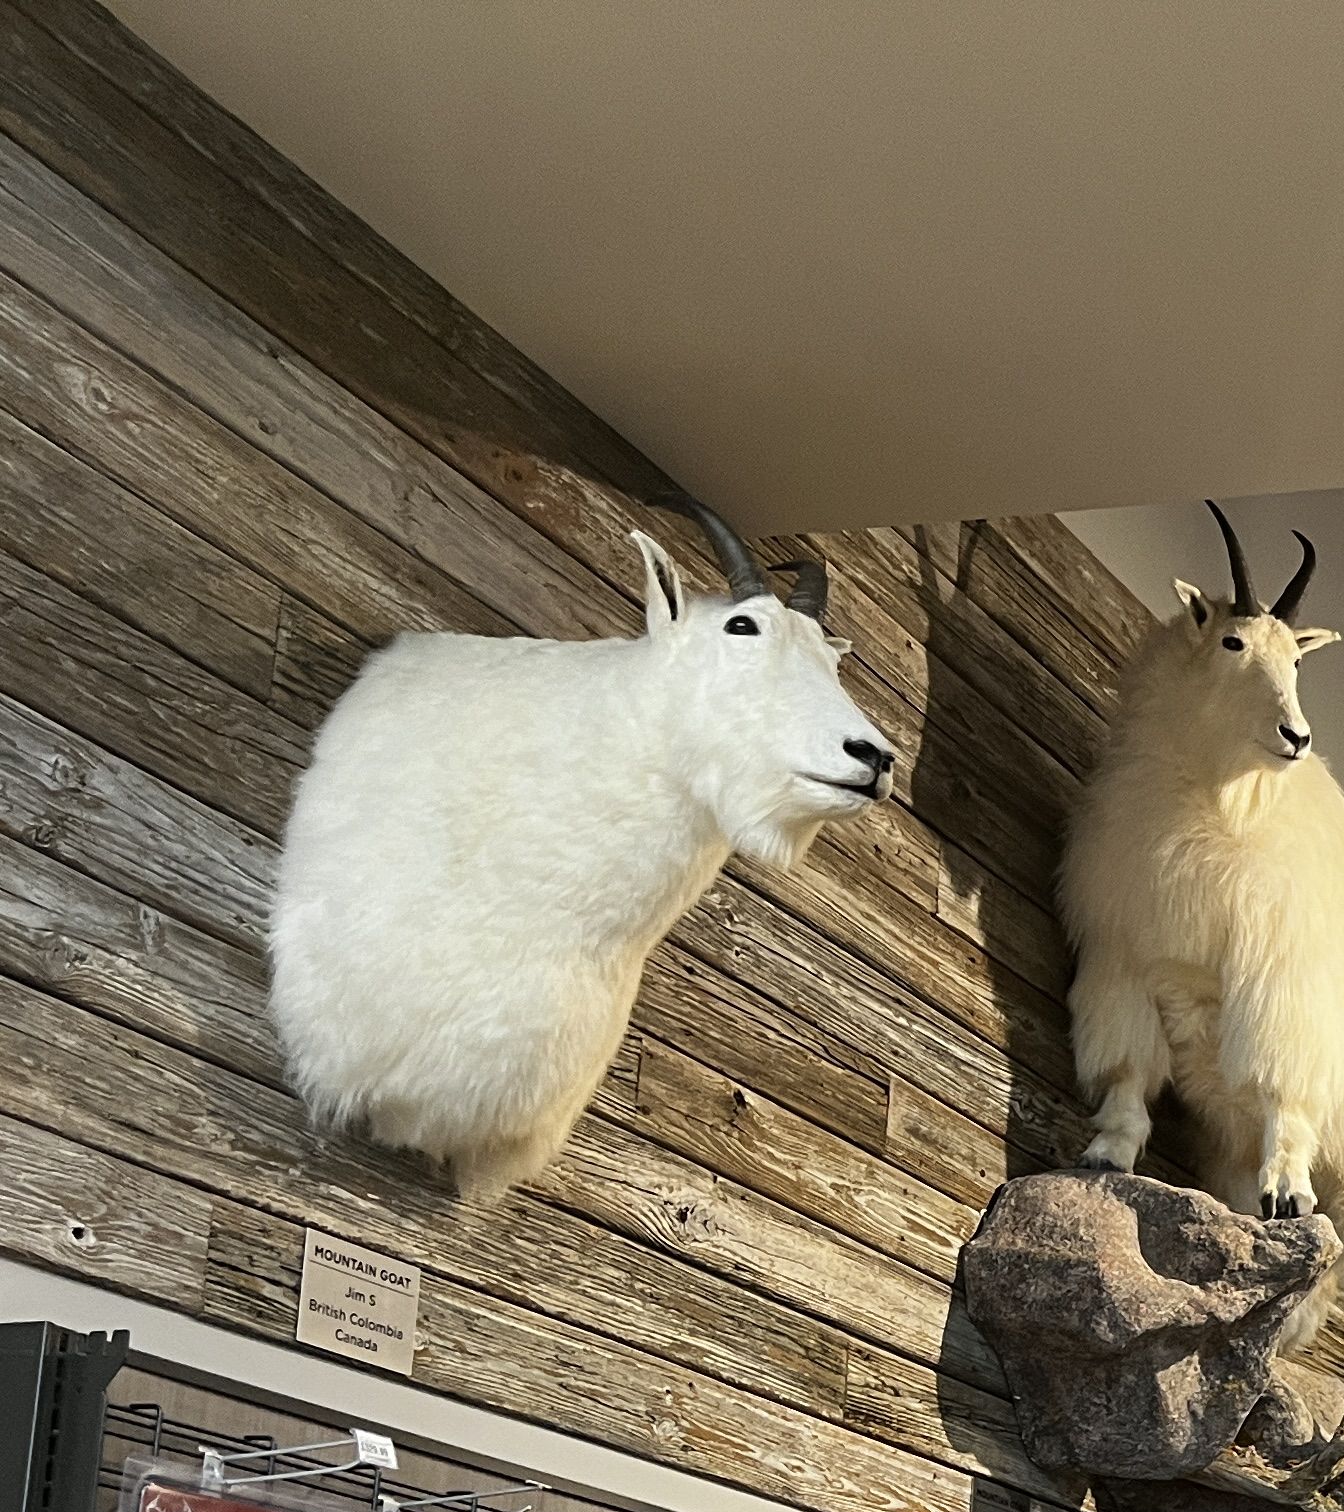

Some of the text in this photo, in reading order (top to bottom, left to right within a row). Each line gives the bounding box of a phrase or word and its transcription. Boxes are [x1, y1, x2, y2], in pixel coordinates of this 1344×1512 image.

[314, 1245, 412, 1289] MOUNTAIN GOAT
[345, 1286, 377, 1307] Jim S
[308, 1298, 404, 1340] British Colombia
[335, 1328, 378, 1352] Canada
